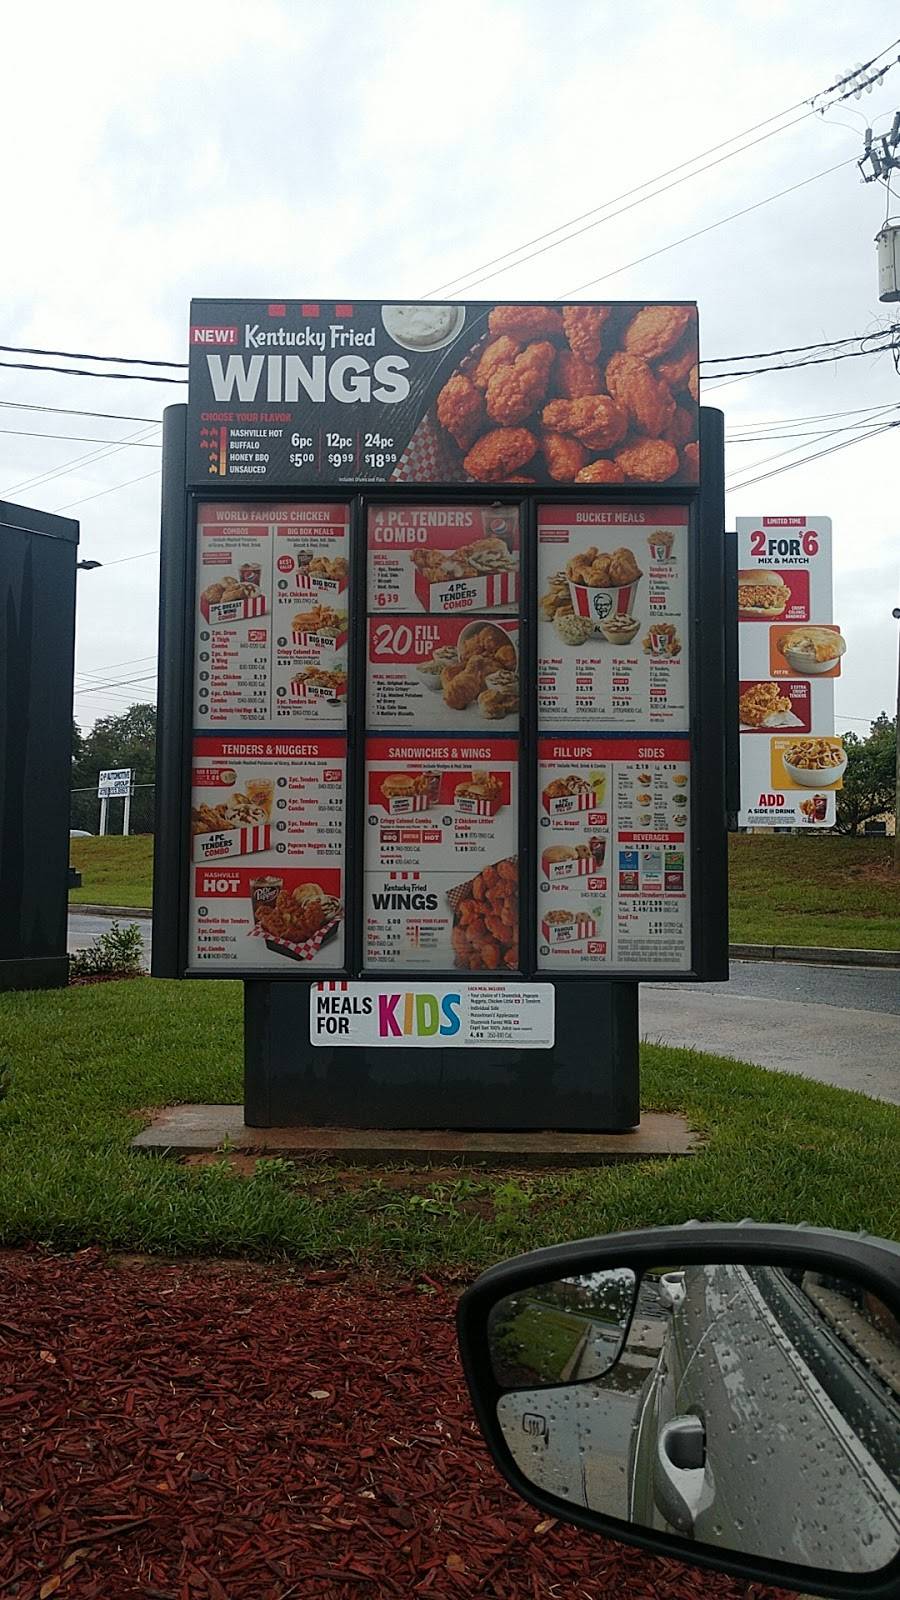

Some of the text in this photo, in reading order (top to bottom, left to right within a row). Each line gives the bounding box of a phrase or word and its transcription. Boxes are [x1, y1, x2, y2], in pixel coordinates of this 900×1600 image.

[194, 330, 234, 342] NEW!
[244, 324, 375, 351] Kentucky Fried
[206, 355, 410, 403] WINGS
[200, 412, 292, 423] CHOOSE YOUR FLAVOR
[230, 429, 284, 438] NASHVILLE HOT
[229, 441, 260, 449] BUFFALO
[291, 433, 313, 449] 6pc
[326, 433, 353, 449] 12pc
[365, 433, 394, 450] 24pc
[229, 453, 270, 463] HONEY BBQ
[229, 465, 267, 474] UNSAUCED
[216, 512, 330, 520] WORLD FAMOUS CHICKEN
[375, 512, 473, 526] 4 PC. TENDERS
[576, 513, 645, 522] BUCKET MEALS
[375, 528, 427, 542] COMBO
[751, 531, 819, 556] 2 FOR $6
[324, 581, 336, 589] BOX
[440, 590, 477, 602] TENDERS
[444, 600, 472, 610] COMBO
[321, 638, 334, 646] BOX
[373, 624, 440, 655] $20 FILL
[415, 641, 433, 655] UP
[222, 745, 318, 755] TENDERS & NUGGETS
[389, 748, 491, 758] SANDWICHES & WINGS
[554, 748, 592, 757] FILL UPS
[638, 748, 665, 758] SIDES
[759, 794, 784, 806] ADD
[201, 840, 232, 851] TENDERS
[205, 848, 230, 857] COMBO
[203, 880, 240, 892] HOT
[384, 884, 410, 892] Kentucky
[372, 894, 438, 910] WINGS
[317, 997, 372, 1015] MEALS
[378, 993, 461, 1037] KIDS
[317, 1017, 349, 1034] FOR
